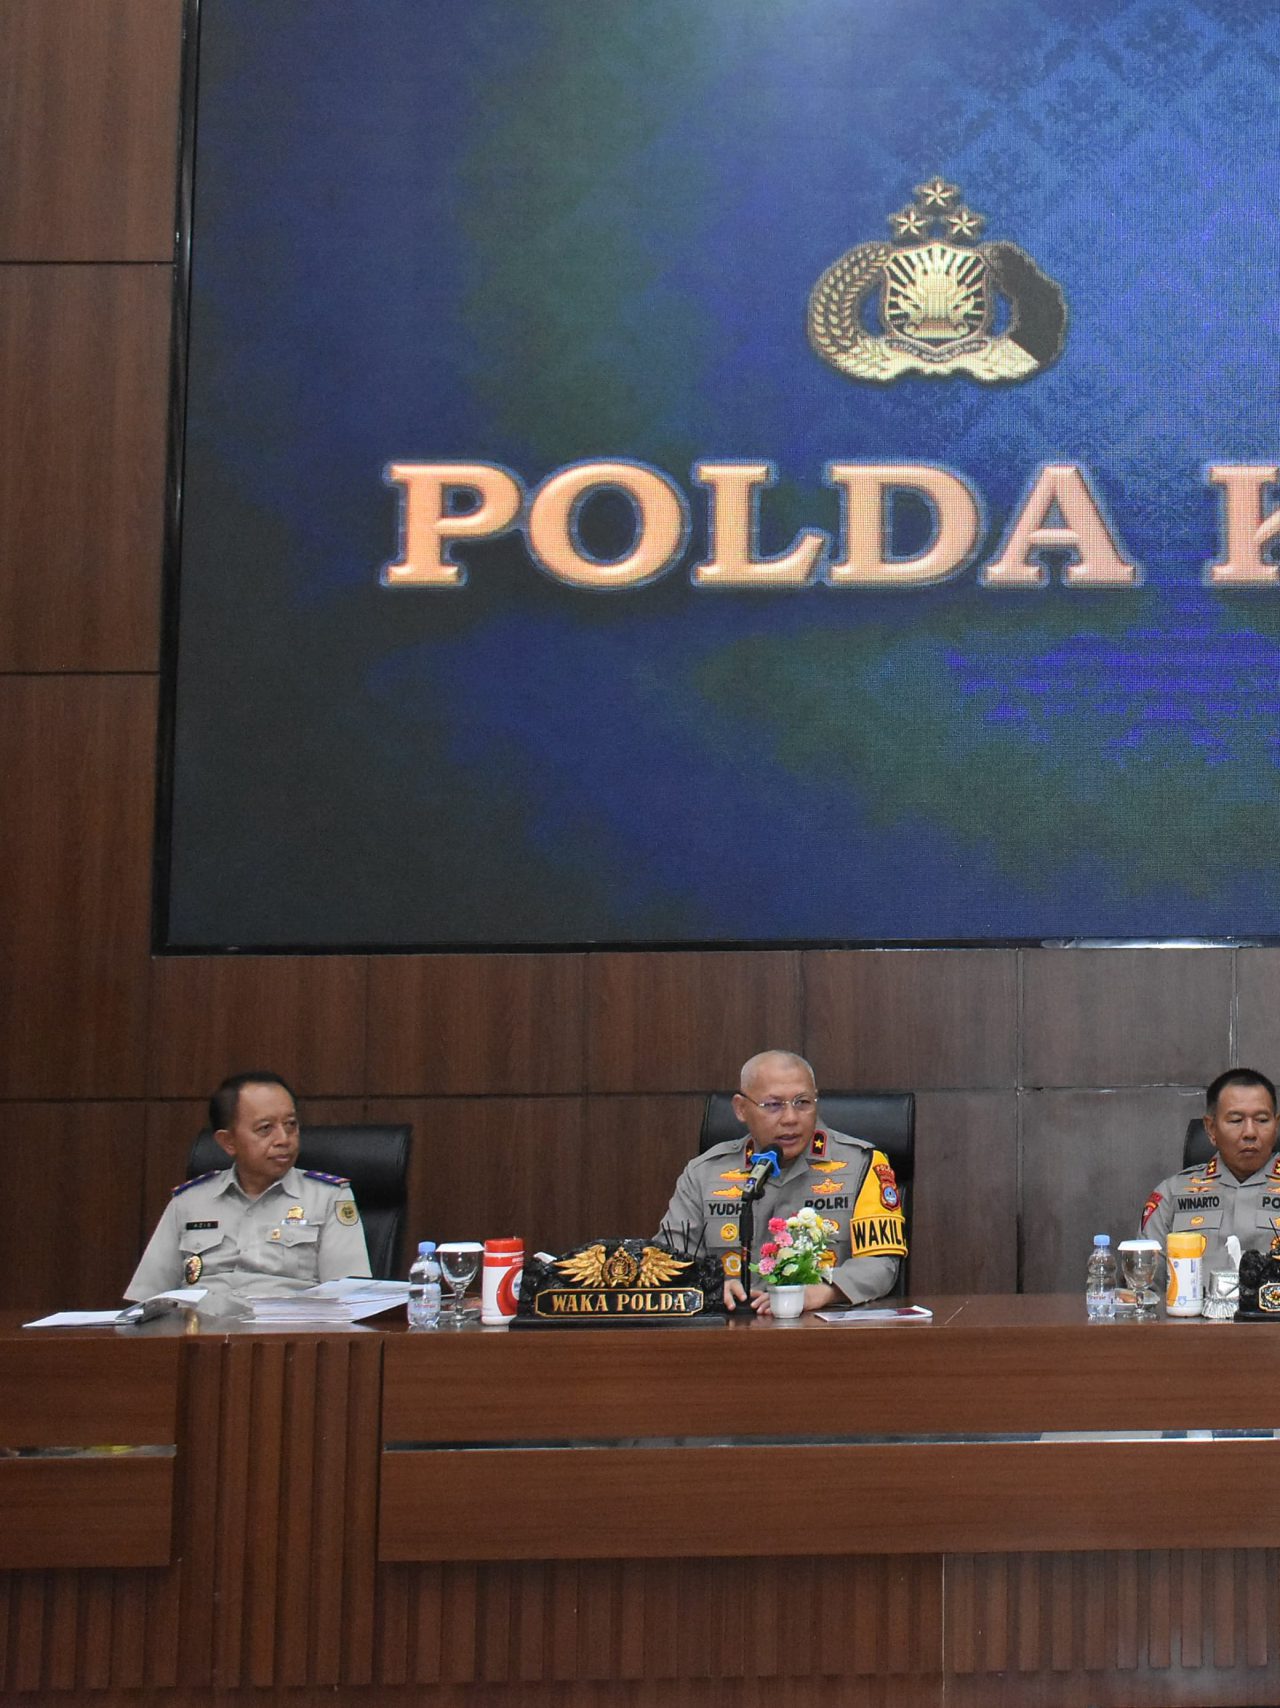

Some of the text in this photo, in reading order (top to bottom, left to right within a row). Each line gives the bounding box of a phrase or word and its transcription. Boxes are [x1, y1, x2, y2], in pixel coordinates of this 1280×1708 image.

[386, 462, 1138, 587] POLDA
[804, 1196, 849, 1211] POLRI
[1177, 1196, 1220, 1211] WINARTO
[552, 1292, 687, 1313] WAKA POLDA
